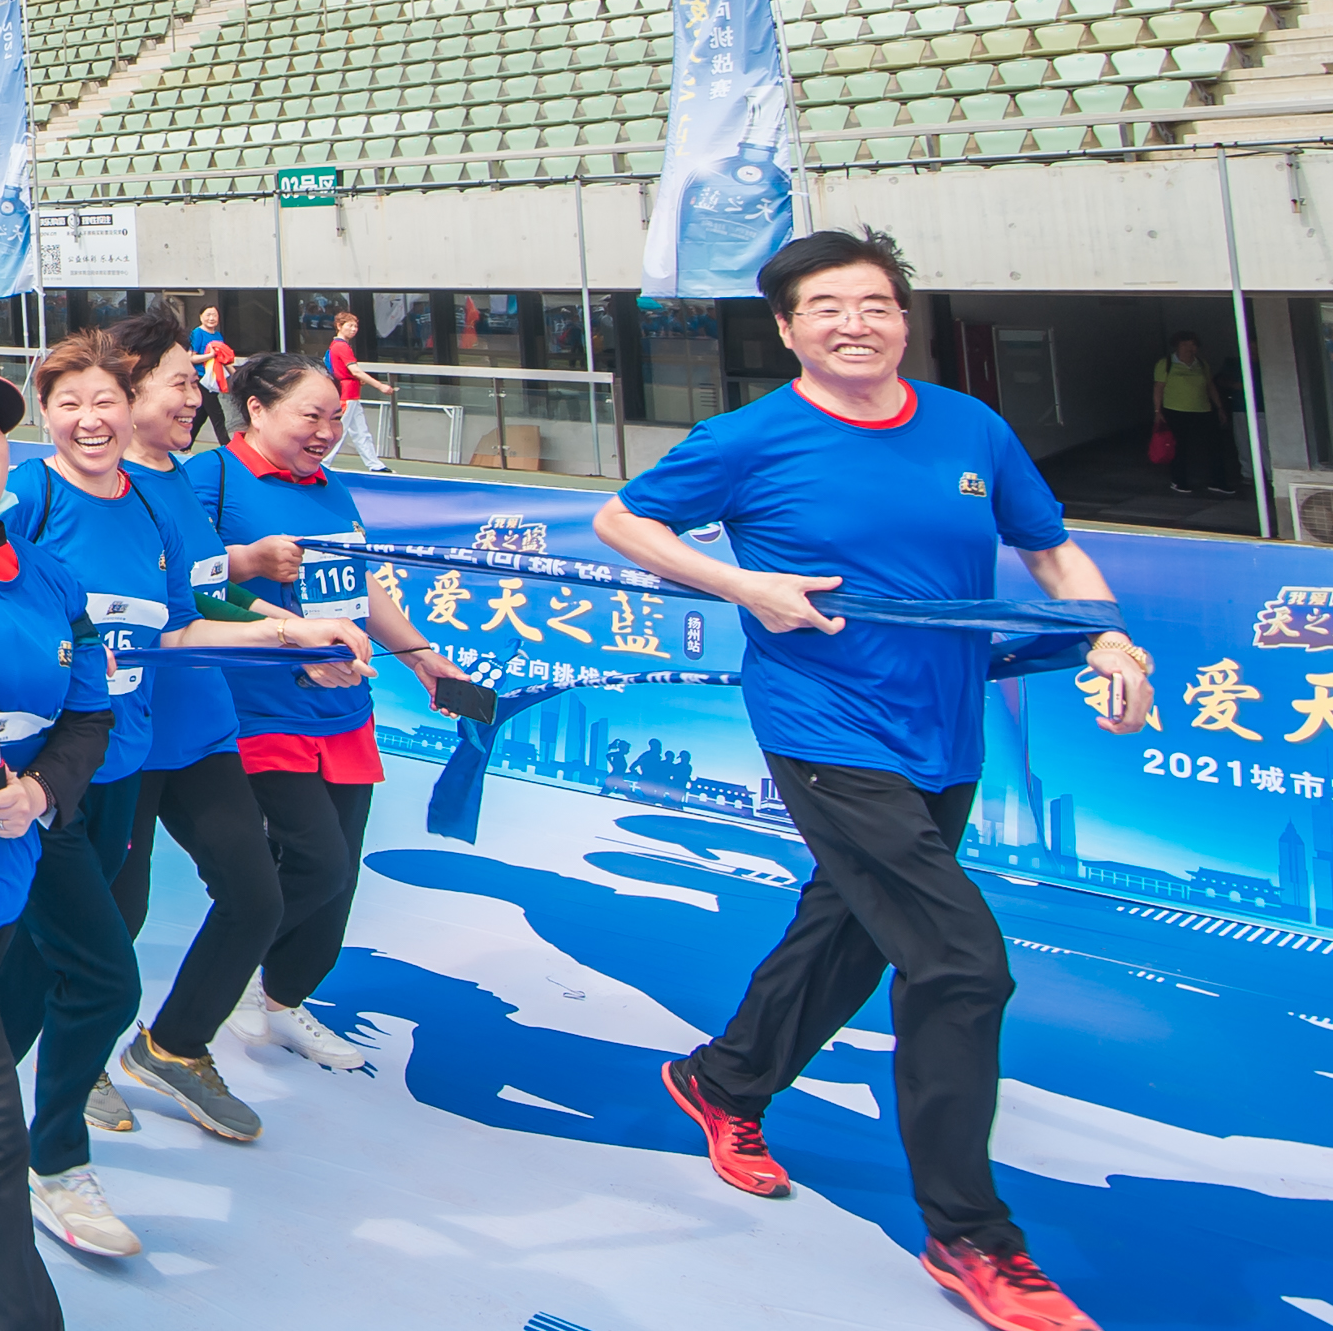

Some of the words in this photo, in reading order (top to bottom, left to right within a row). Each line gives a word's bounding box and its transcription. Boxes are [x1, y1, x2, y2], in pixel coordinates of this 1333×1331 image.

[315, 565, 356, 595] 116
[686, 616, 702, 654] 扬州站
